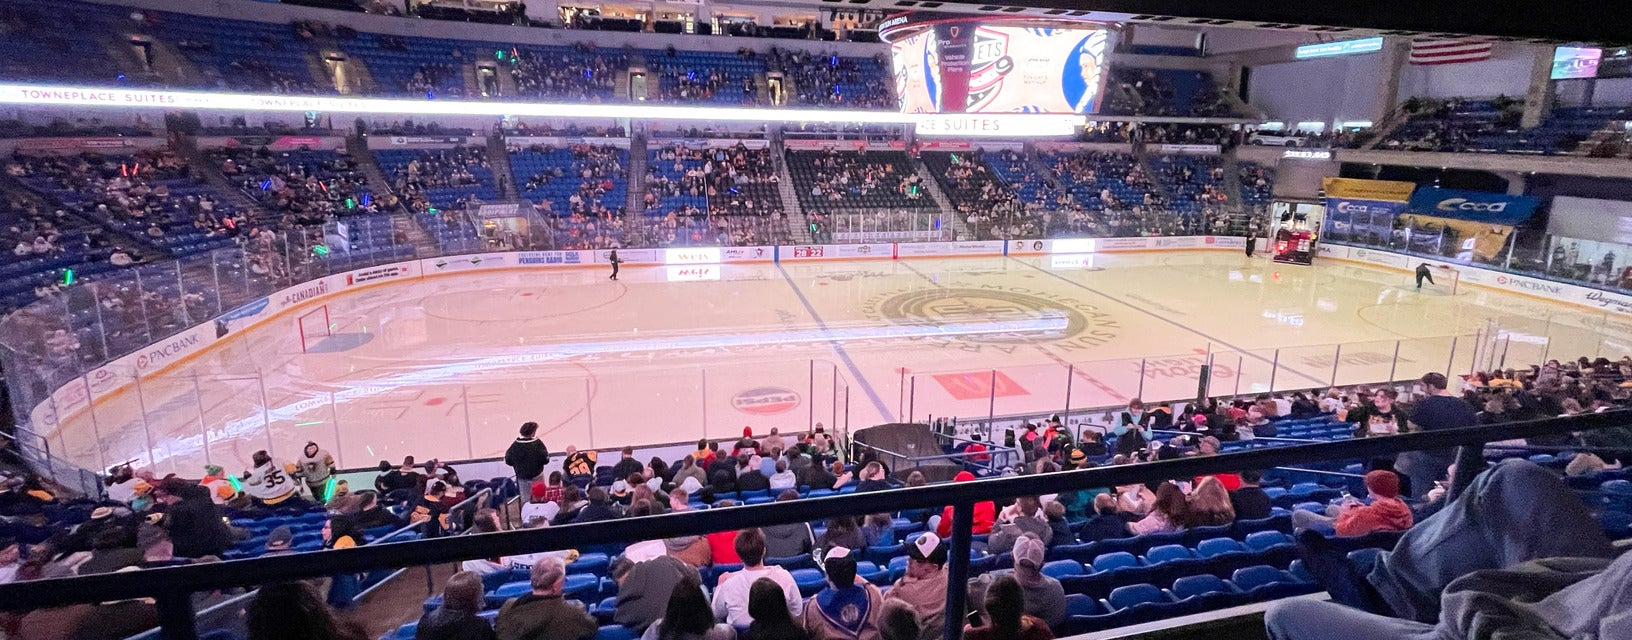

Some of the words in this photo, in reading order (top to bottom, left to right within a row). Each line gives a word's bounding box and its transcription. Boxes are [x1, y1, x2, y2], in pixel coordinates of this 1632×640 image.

[22, 89, 116, 102] TOWNEPLACE
[125, 93, 175, 104] SUITES
[944, 118, 1000, 131] SUITES
[1056, 330, 1116, 351] SUN
[263, 469, 286, 488] 35
